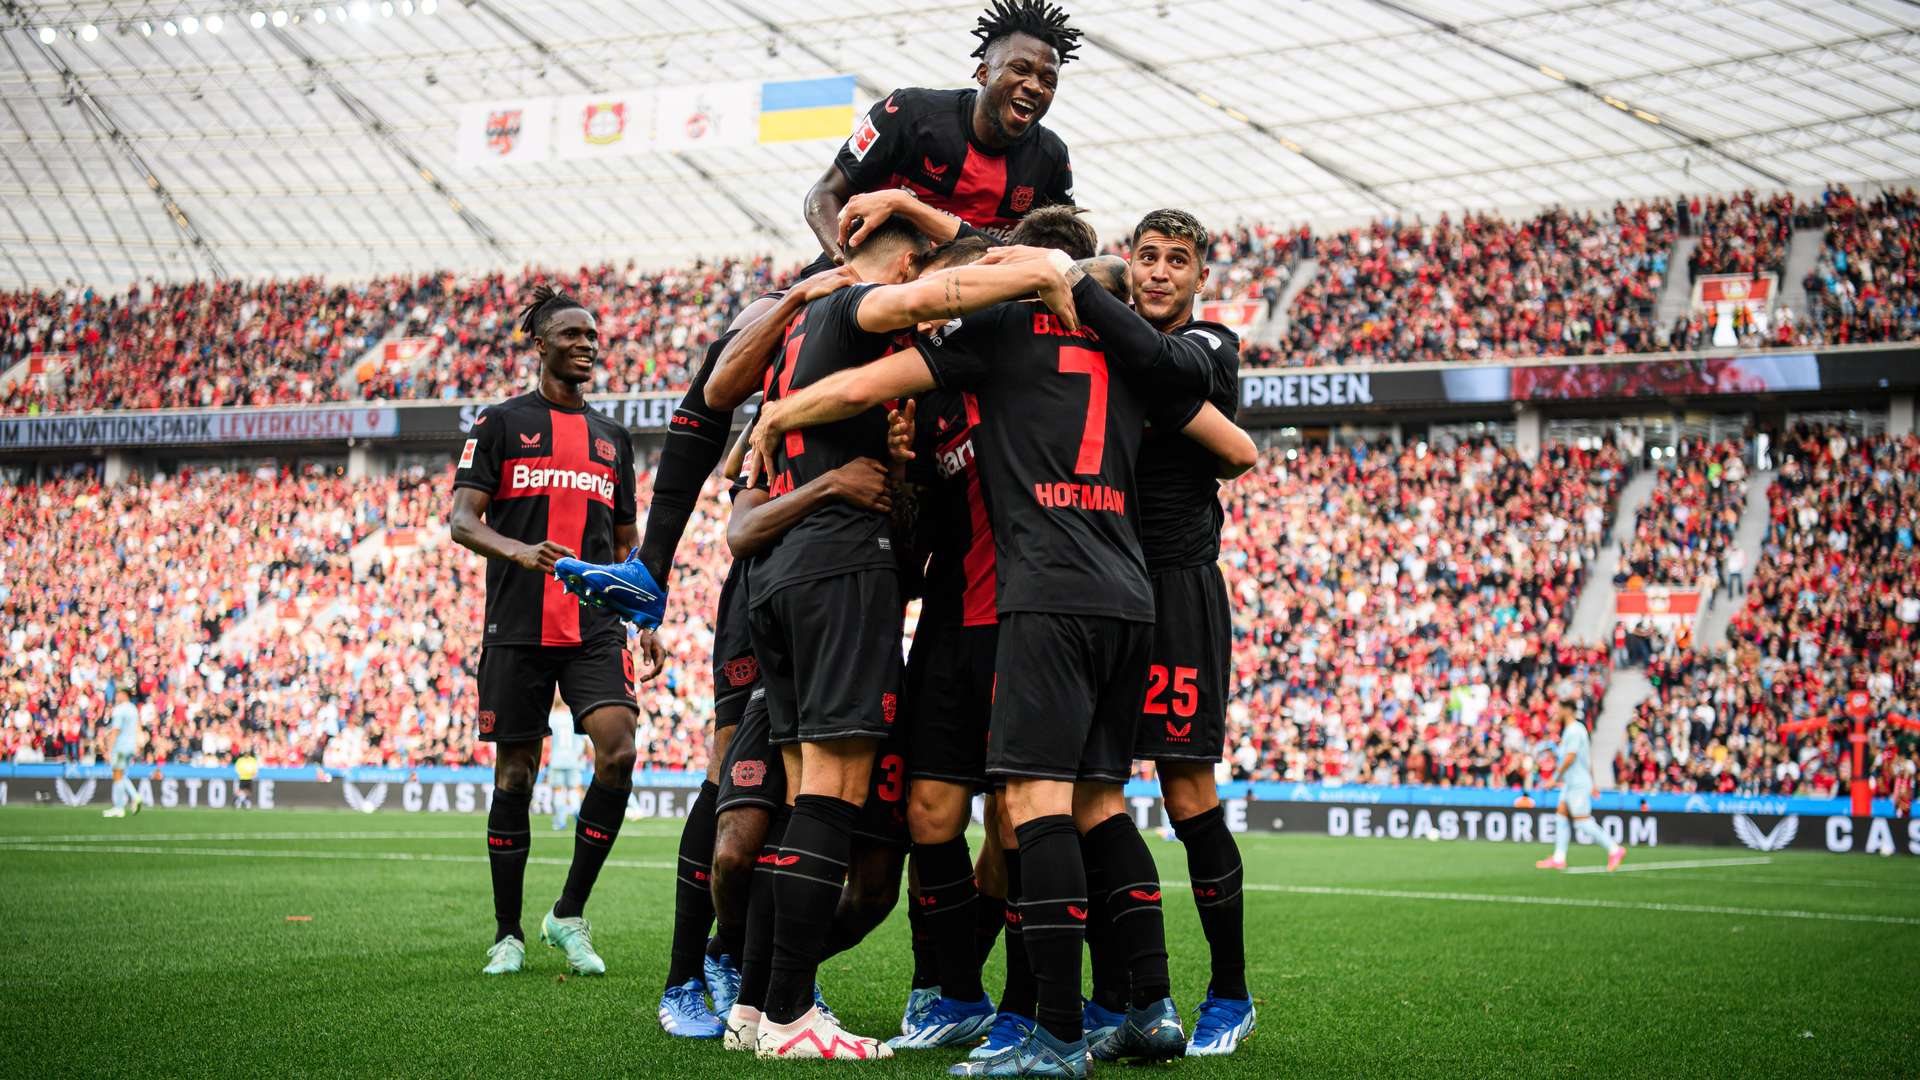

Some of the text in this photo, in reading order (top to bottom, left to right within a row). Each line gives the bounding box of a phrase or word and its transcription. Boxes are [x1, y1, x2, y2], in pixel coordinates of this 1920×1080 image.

[1057, 345, 1109, 475] 7
[1242, 373, 1373, 408] PREISEN.
[28, 415, 211, 446] INNOVATIONSPARK
[219, 409, 353, 440] LEVERKUSEN
[512, 464, 615, 501] Barmenia
[1143, 664, 1199, 718] 25
[878, 754, 904, 802] 3
